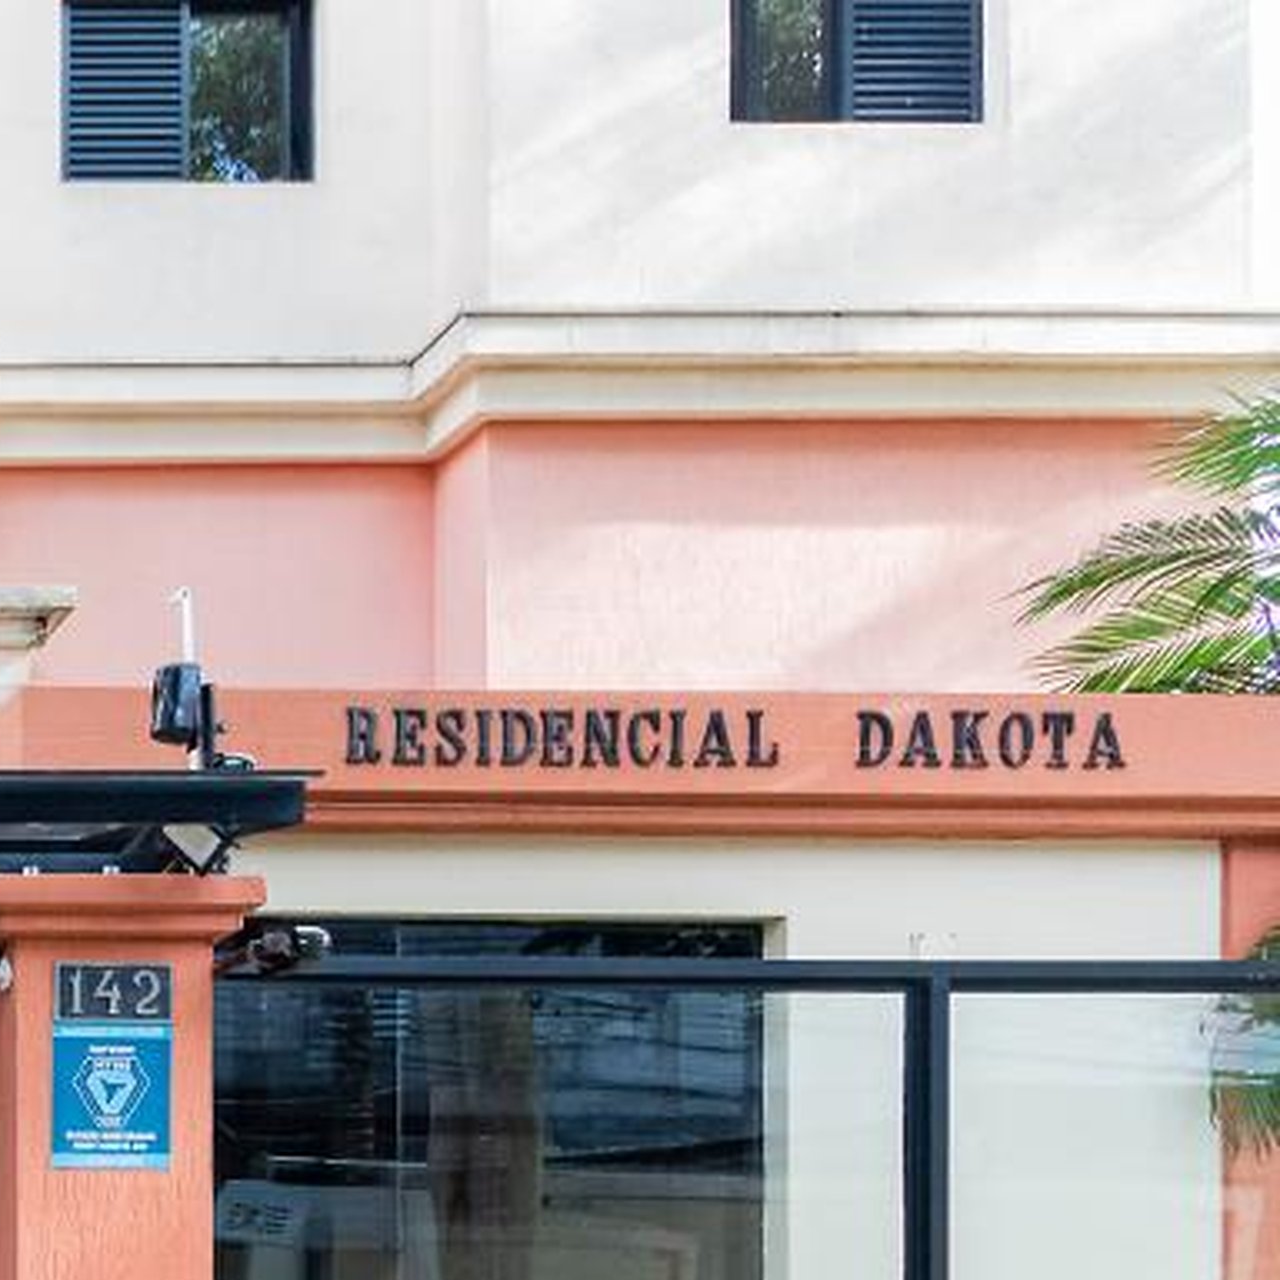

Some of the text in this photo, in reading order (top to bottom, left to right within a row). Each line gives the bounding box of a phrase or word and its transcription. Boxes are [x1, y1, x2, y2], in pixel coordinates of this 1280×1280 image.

[345, 706, 1127, 771] RESIDENCIAL DAKOTA
[69, 968, 161, 1015] 142
